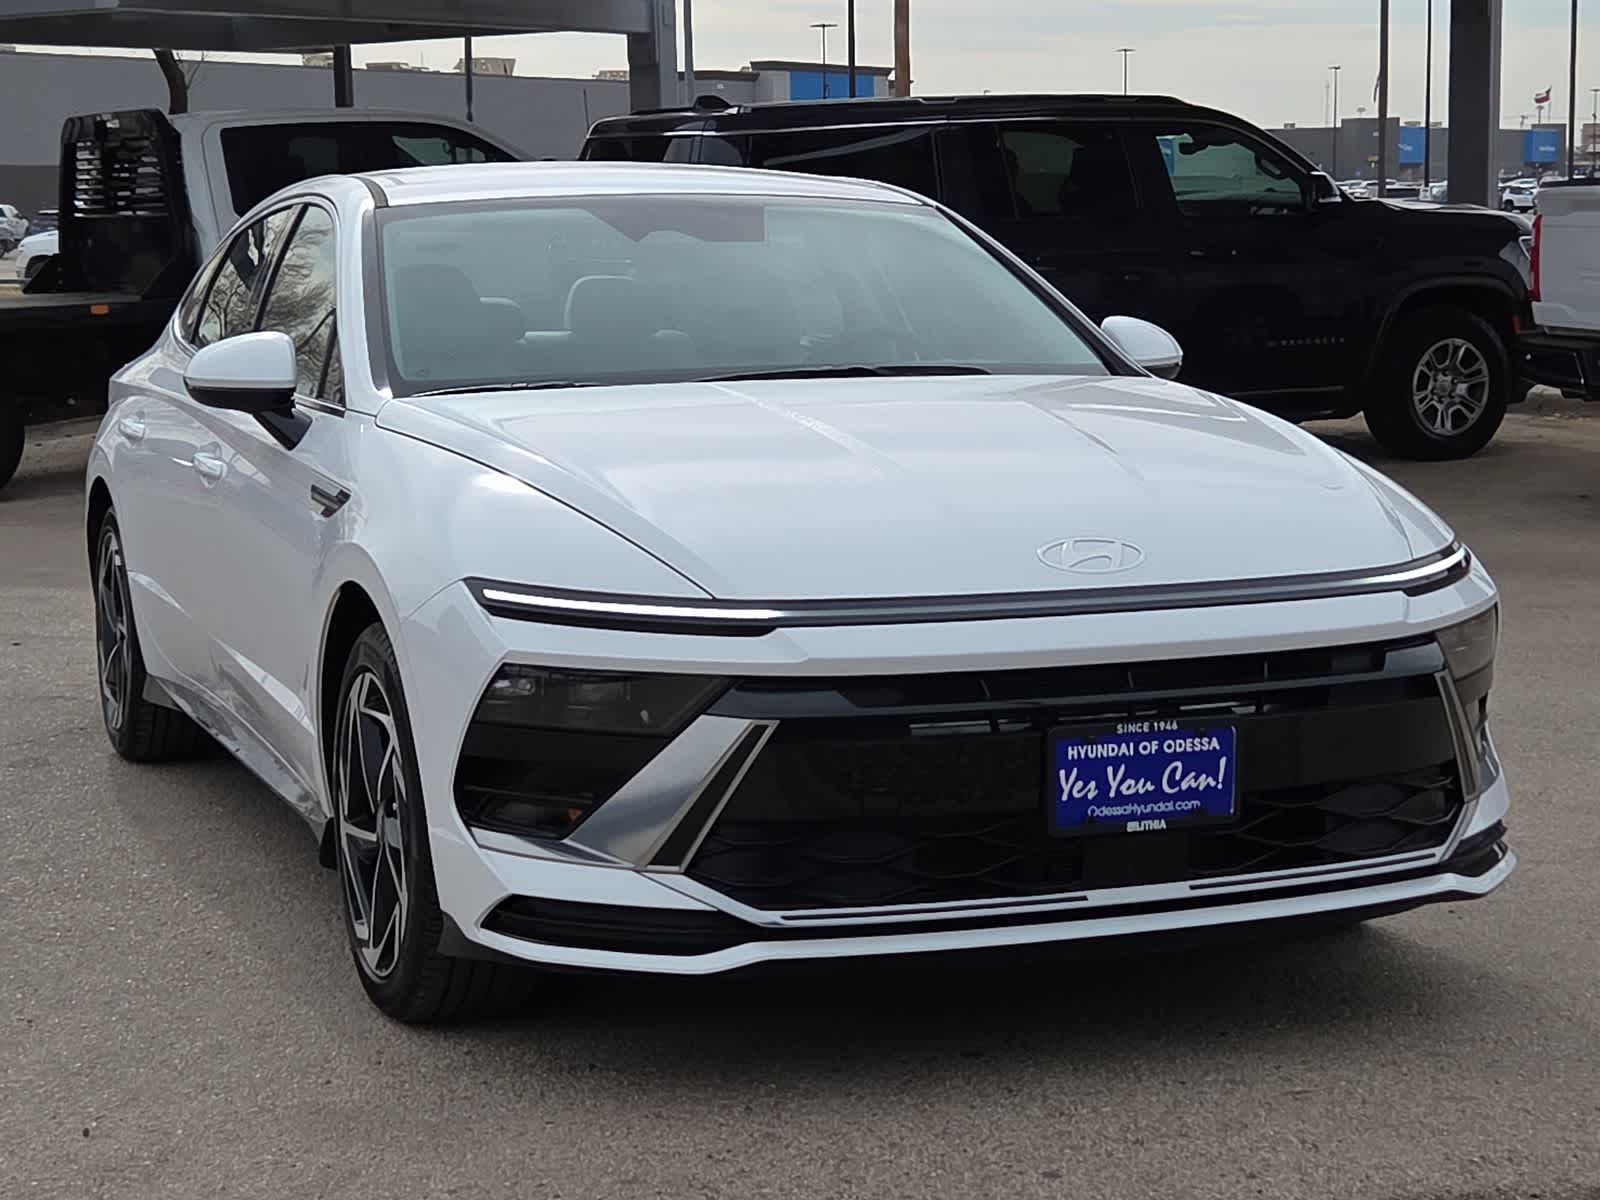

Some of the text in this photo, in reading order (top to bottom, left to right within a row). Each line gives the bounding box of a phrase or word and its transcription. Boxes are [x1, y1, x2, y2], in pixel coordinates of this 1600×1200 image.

[1117, 722, 1149, 734] SINCE
[1068, 737, 1220, 760] HYUNDAI OF ODESSA
[1059, 756, 1227, 801] Yes You Can!
